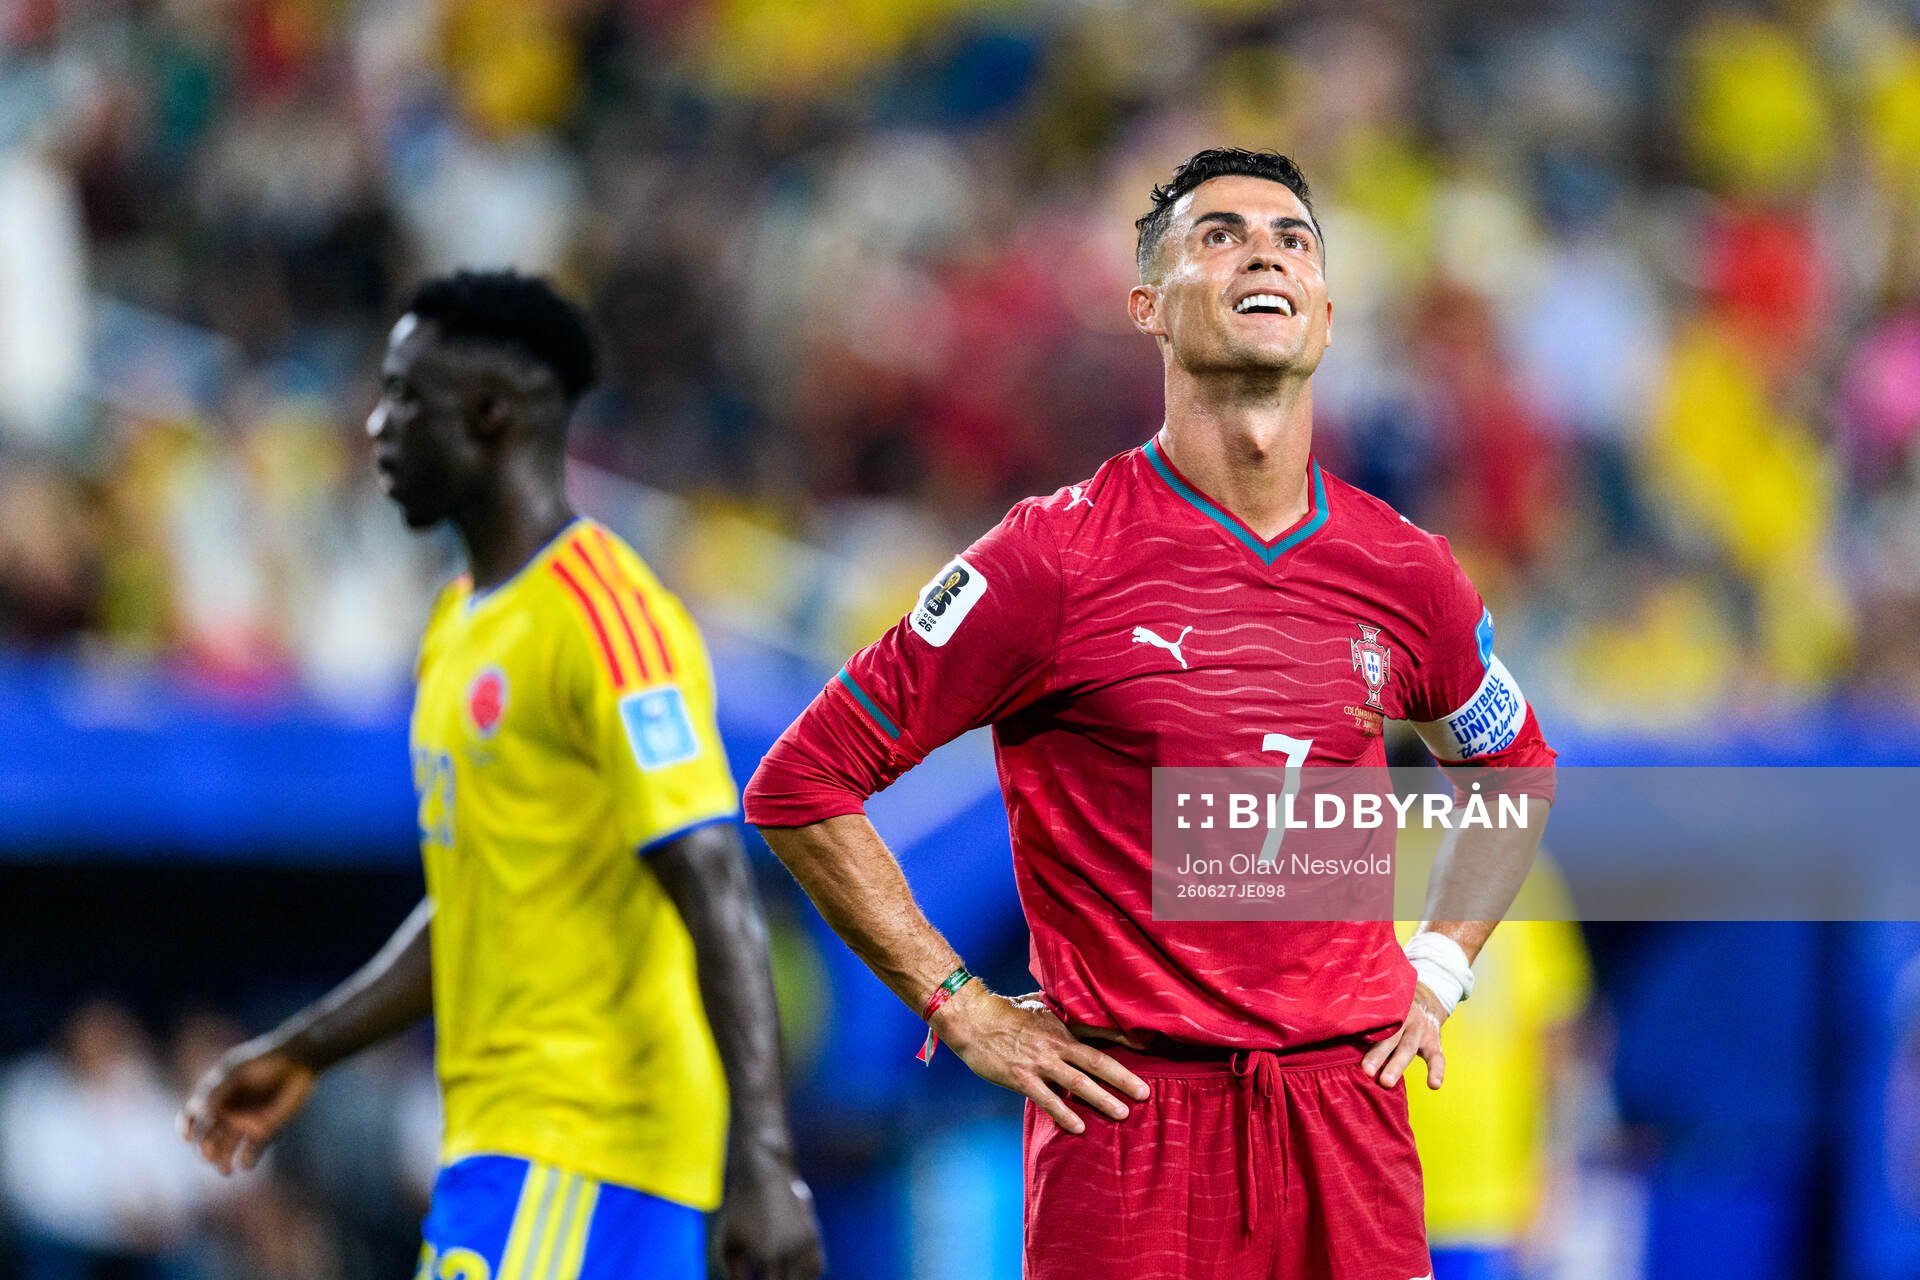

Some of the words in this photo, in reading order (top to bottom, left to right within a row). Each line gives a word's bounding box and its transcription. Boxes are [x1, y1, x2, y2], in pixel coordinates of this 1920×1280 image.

[918, 618, 933, 632] 26
[1447, 674, 1500, 731] FOOTBALL
[1453, 682, 1511, 745] UNITES
[1456, 741, 1488, 760] the
[1487, 694, 1520, 744] World
[1257, 733, 1314, 867] 7
